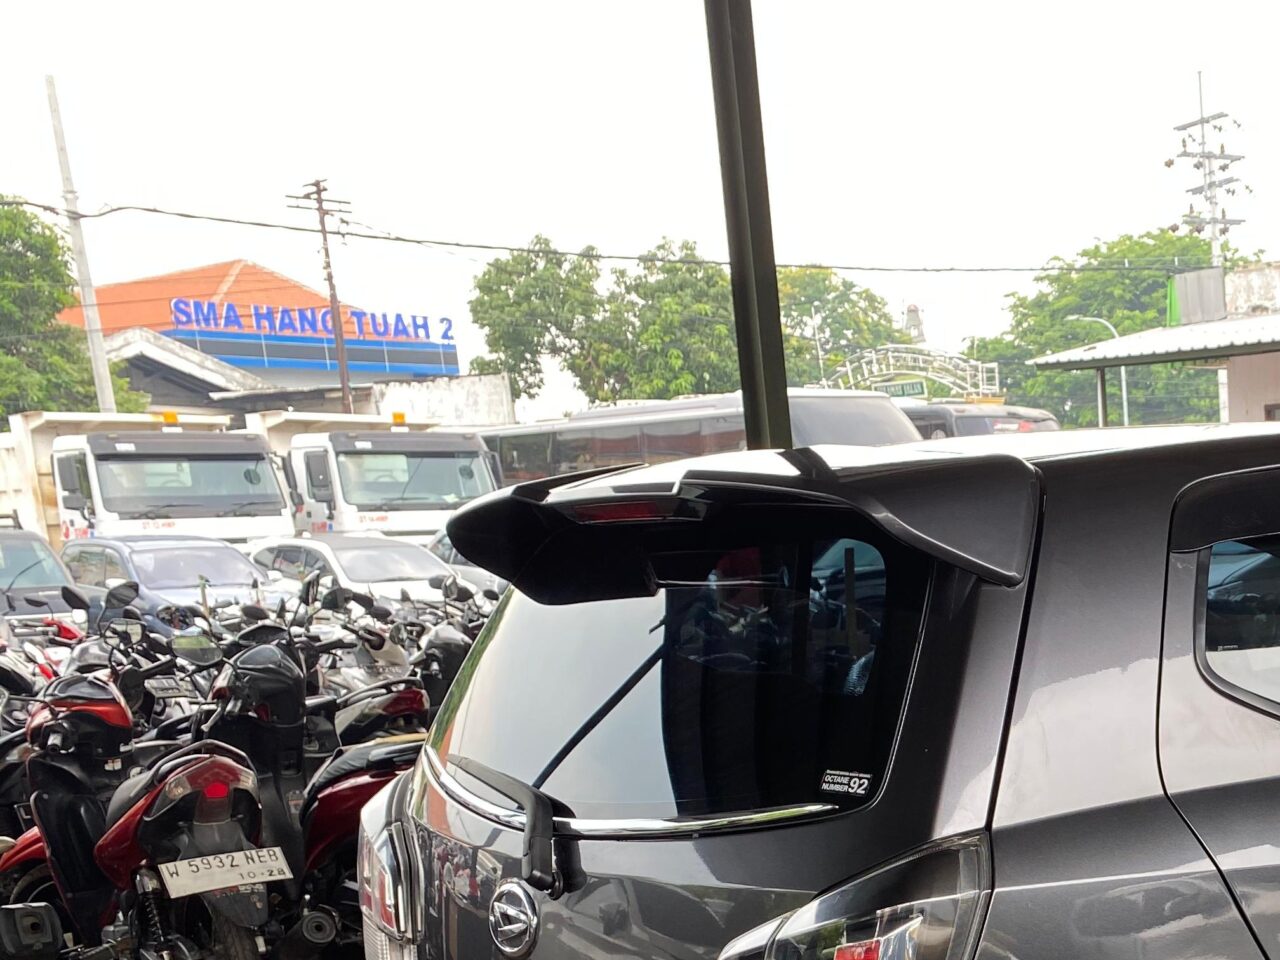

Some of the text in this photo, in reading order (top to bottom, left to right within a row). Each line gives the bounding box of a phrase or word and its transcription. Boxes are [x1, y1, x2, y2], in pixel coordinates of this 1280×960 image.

[171, 298, 243, 329] SMA
[351, 310, 430, 340] TUAH
[440, 317, 454, 340] 2
[821, 782, 849, 792] NUMBER
[825, 775, 850, 784] OCTANE
[848, 777, 869, 794] 92
[166, 848, 279, 878] W 5932 NEB
